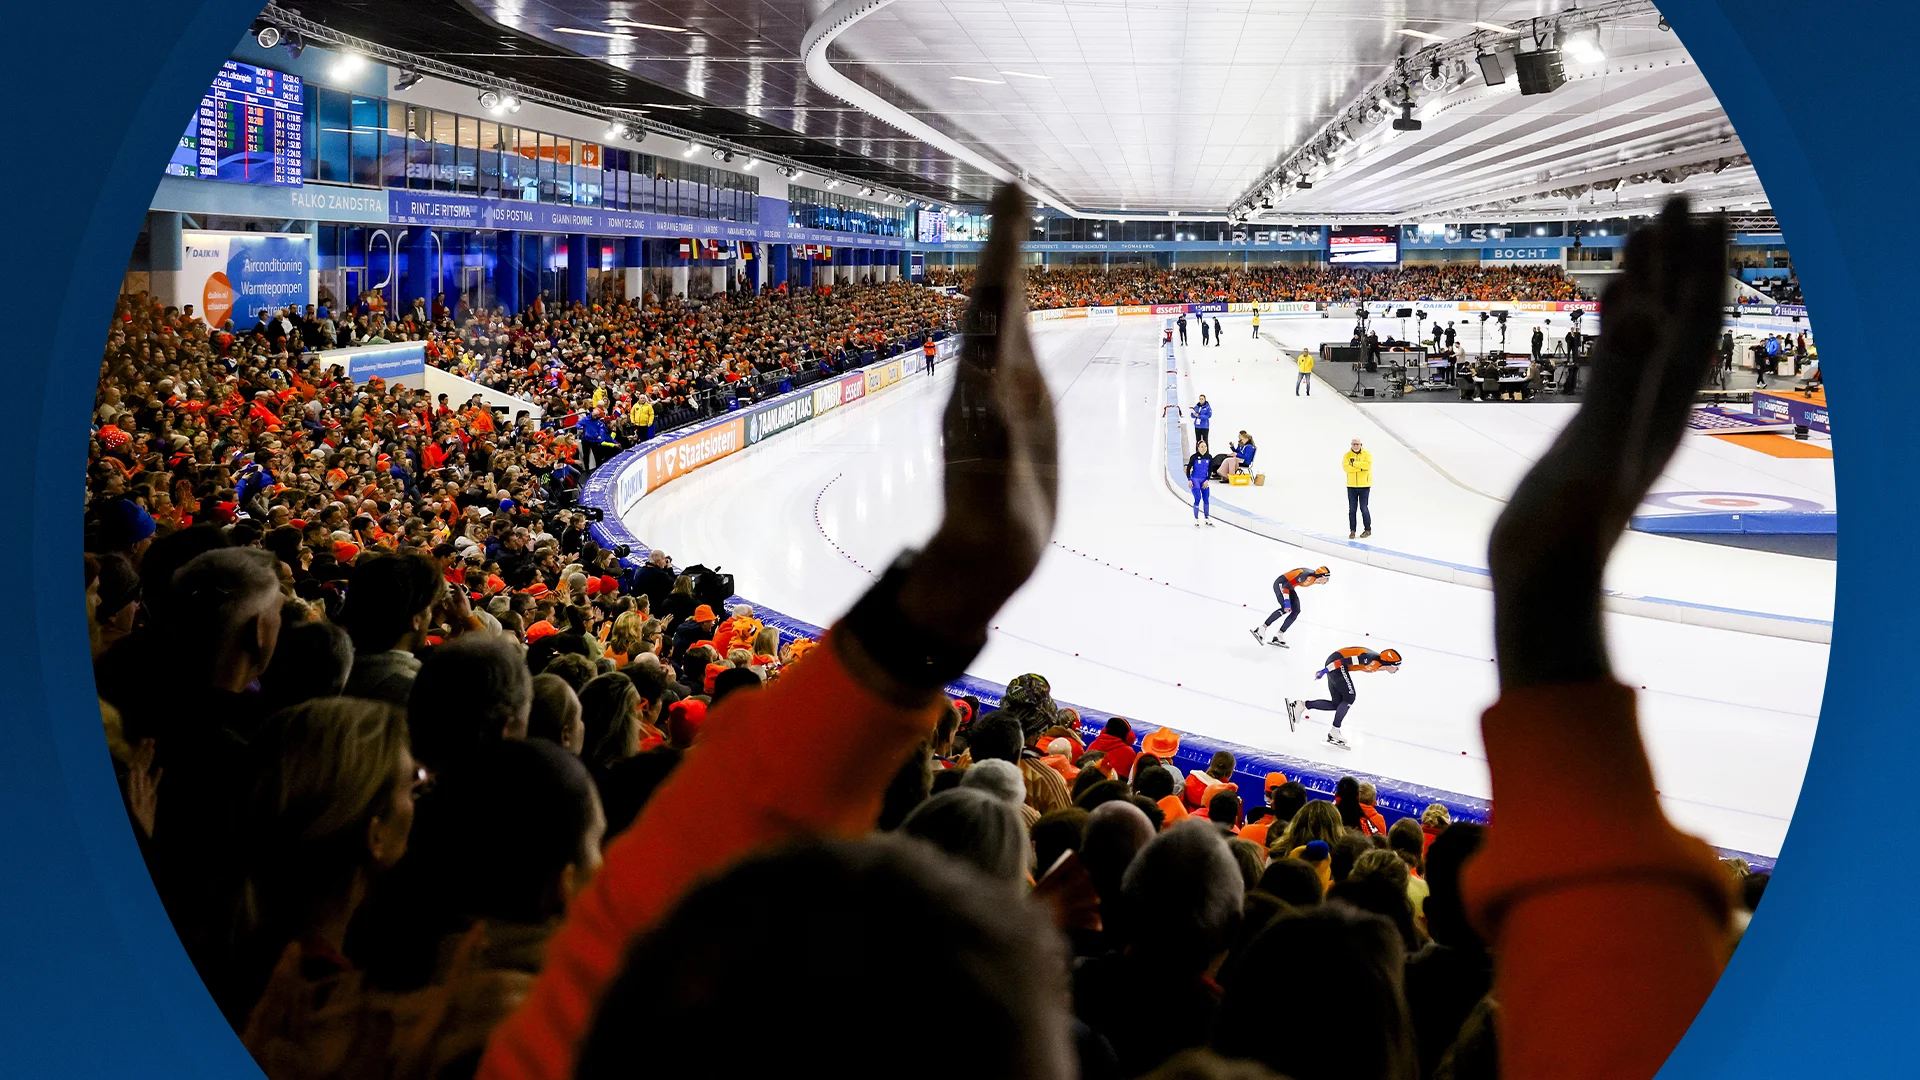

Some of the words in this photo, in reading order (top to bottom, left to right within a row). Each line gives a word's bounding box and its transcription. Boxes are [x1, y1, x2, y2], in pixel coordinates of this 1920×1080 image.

[256, 68, 266, 76] NOR
[256, 76, 264, 86] ITA
[256, 86, 266, 96] NED
[218, 102, 227, 110] 19.7
[218, 130, 227, 138] 31.4
[218, 140, 227, 148] 31.9
[291, 192, 326, 208] FALKO
[328, 195, 382, 212] ZANDSTRA
[411, 202, 440, 216] RINTJE
[442, 204, 471, 218] RITSMA
[493, 209, 504, 220] IDS
[506, 210, 534, 222] POSTMA
[552, 213, 570, 224] GIANNI
[572, 214, 593, 226] ROMME
[608, 218, 624, 228] TONNY
[625, 219, 632, 228] DE
[1218, 231, 1318, 245] IREEN
[193, 249, 219, 258] DAIKIN
[1494, 249, 1547, 258] BOCHT
[244, 258, 302, 274] Airconditioning
[241, 281, 302, 297] Warmtepompen
[1156, 305, 1182, 314] essent
[1564, 303, 1596, 311] essent
[846, 376, 863, 402] essent
[815, 384, 840, 414] JUMBO
[758, 401, 796, 440] ZAANLANDER
[797, 396, 812, 420] KAAS
[679, 422, 736, 470] Staatsloterij
[622, 468, 643, 505] DAIKIN
